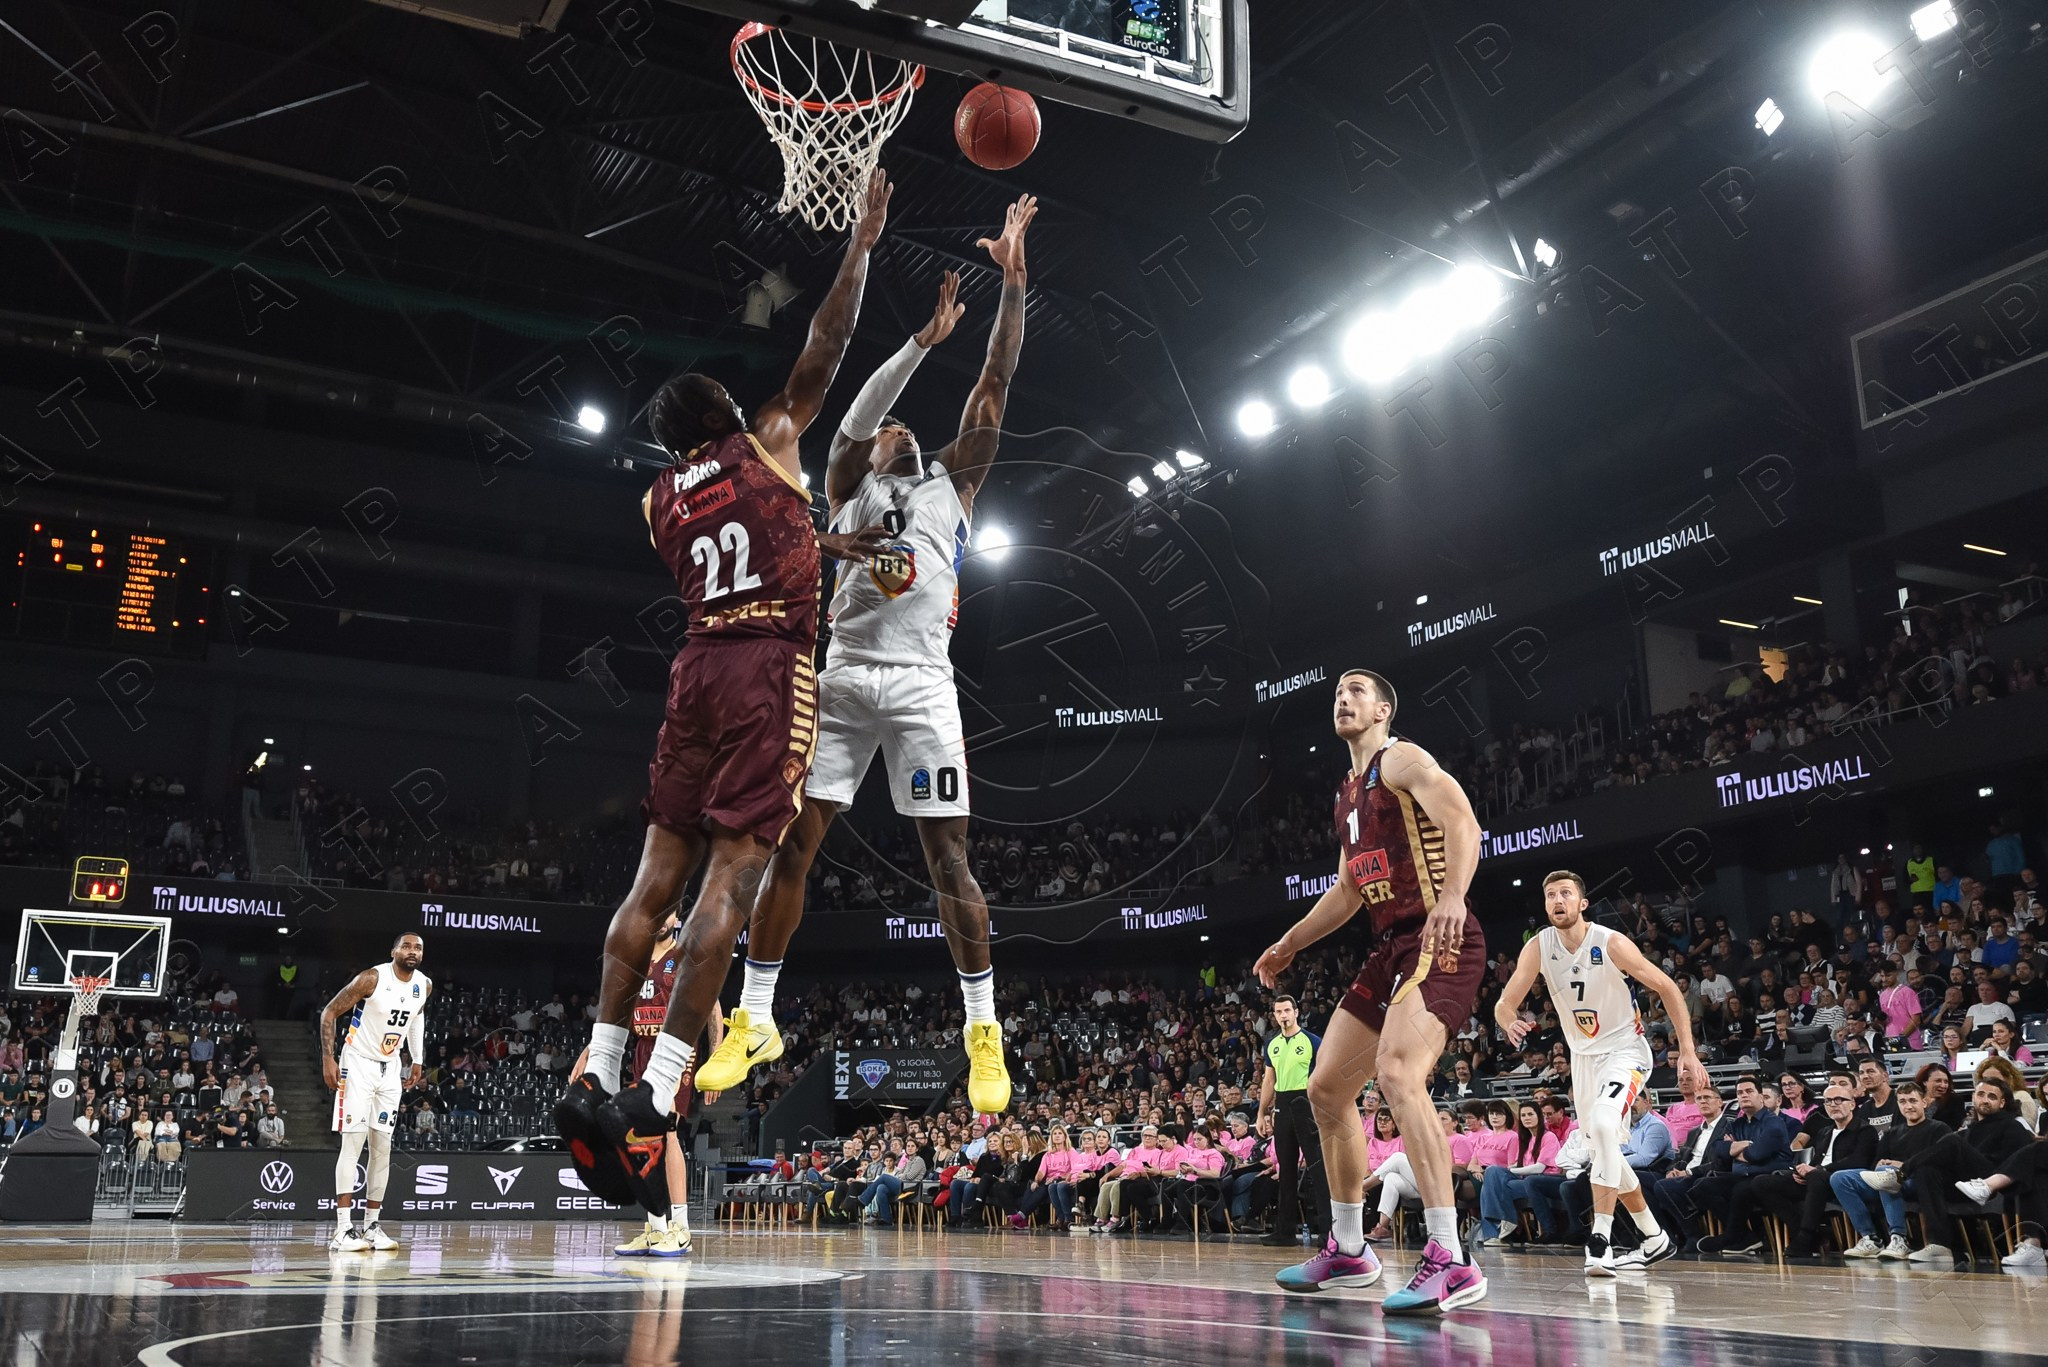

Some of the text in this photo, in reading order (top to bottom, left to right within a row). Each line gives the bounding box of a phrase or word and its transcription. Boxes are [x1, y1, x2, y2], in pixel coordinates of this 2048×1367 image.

[1124, 35, 1169, 56] EuroCup
[676, 486, 730, 520] UMANA
[883, 509, 906, 539] 0
[1621, 522, 1715, 570] IULIUSMALL
[690, 521, 762, 601] 22
[881, 559, 906, 573] BT
[1423, 603, 1497, 642] IULIUSMALL
[1269, 666, 1327, 699] IULIUSMALL
[1076, 707, 1164, 726] IULIUSMALL
[937, 767, 958, 802] 0
[1746, 755, 1871, 802] IULIUSMALL
[1493, 819, 1584, 856] IULIUSMALL
[178, 895, 286, 917] IULIUSMALL
[1144, 903, 1208, 929] IULIUSMALL
[444, 911, 541, 933] IULIUSMALL
[640, 980, 654, 999] 45
[1570, 981, 1585, 1001] 7
[387, 1009, 410, 1027] 35
[1578, 1016, 1595, 1026] BT
[835, 1050, 850, 1100] NEXT
[858, 1065, 888, 1073] IGOKEA
[923, 1070, 942, 1078] 18:30
[252, 1198, 296, 1210] Service
[402, 1200, 458, 1210] SEAT
[470, 1201, 535, 1210] CUPRA
